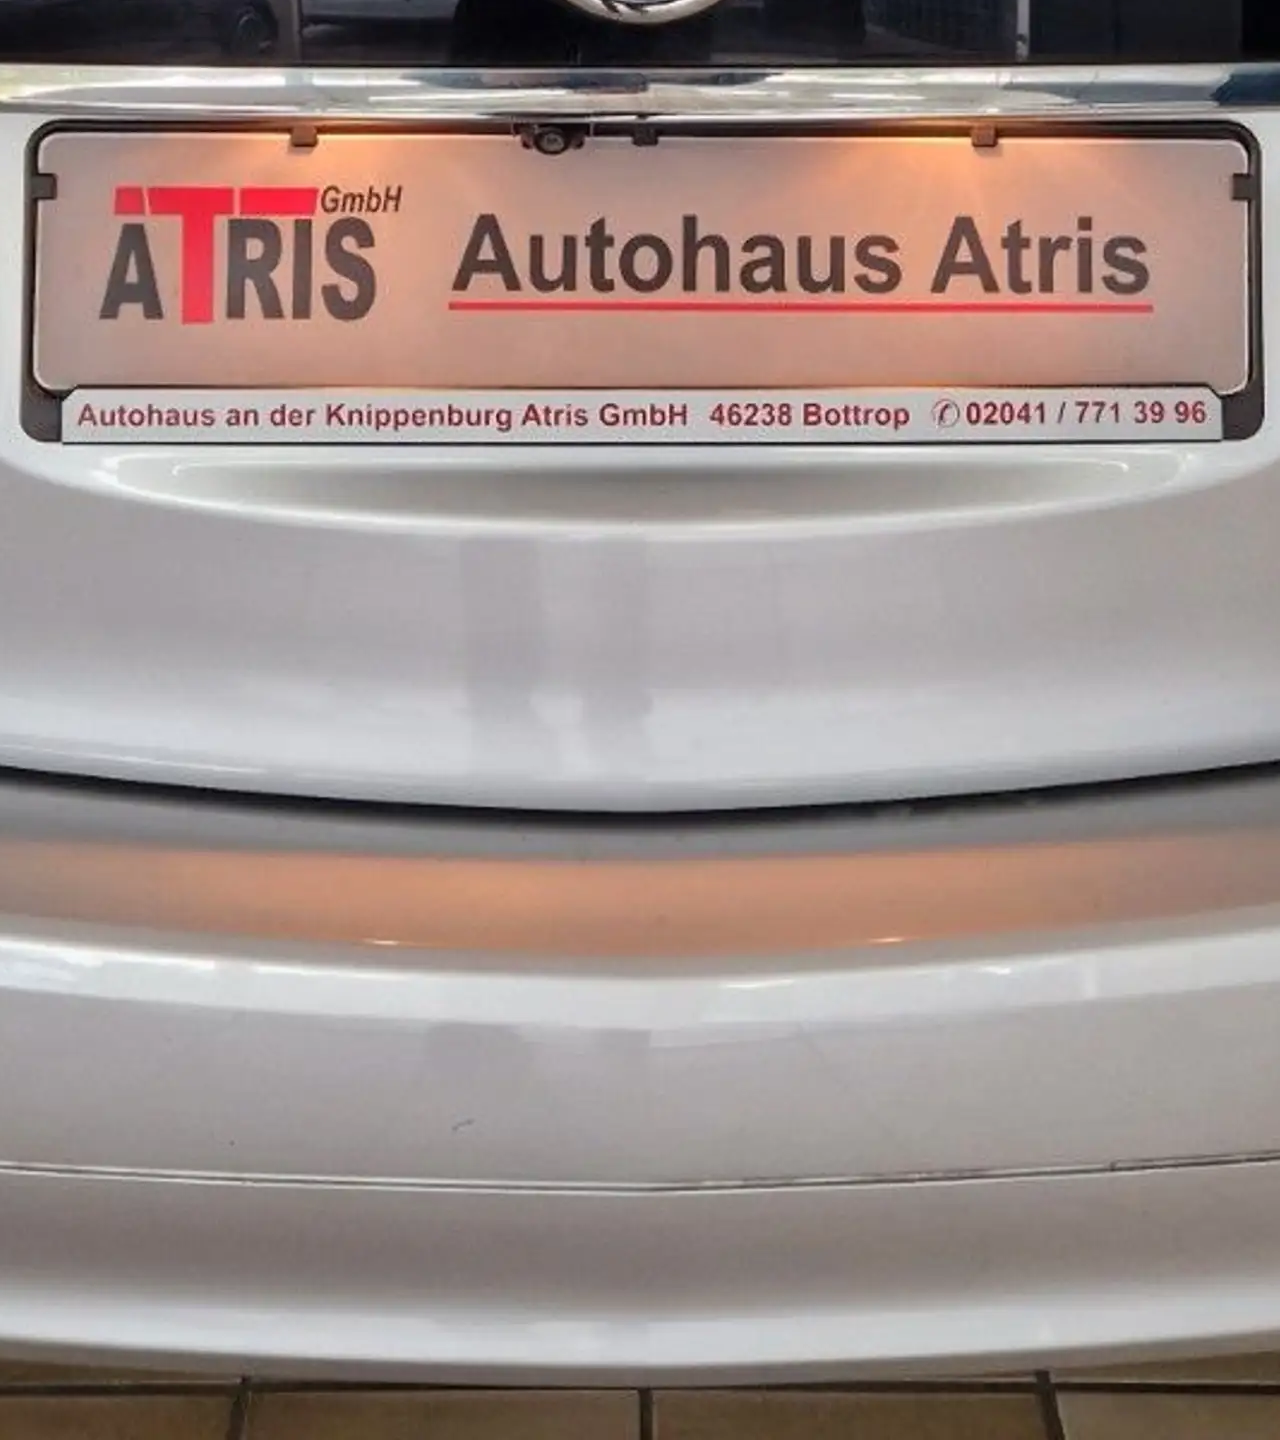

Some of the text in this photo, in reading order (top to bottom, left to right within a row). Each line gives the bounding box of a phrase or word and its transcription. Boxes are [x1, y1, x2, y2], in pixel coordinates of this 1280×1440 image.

[320, 185, 403, 214] GmbH
[452, 213, 1150, 295] Autohaus Atris
[77, 403, 217, 429] Autohaus
[225, 408, 260, 429] an
[269, 403, 317, 429] der
[325, 403, 513, 435] Knippenburg
[520, 402, 589, 429] Atris
[598, 402, 688, 428] GmbH
[708, 402, 793, 428] 46238
[802, 401, 911, 432] Bottrop
[966, 401, 1046, 427] 02041
[1074, 400, 1120, 426] 771
[1133, 400, 1166, 426] 39
[1173, 400, 1207, 426] 96
